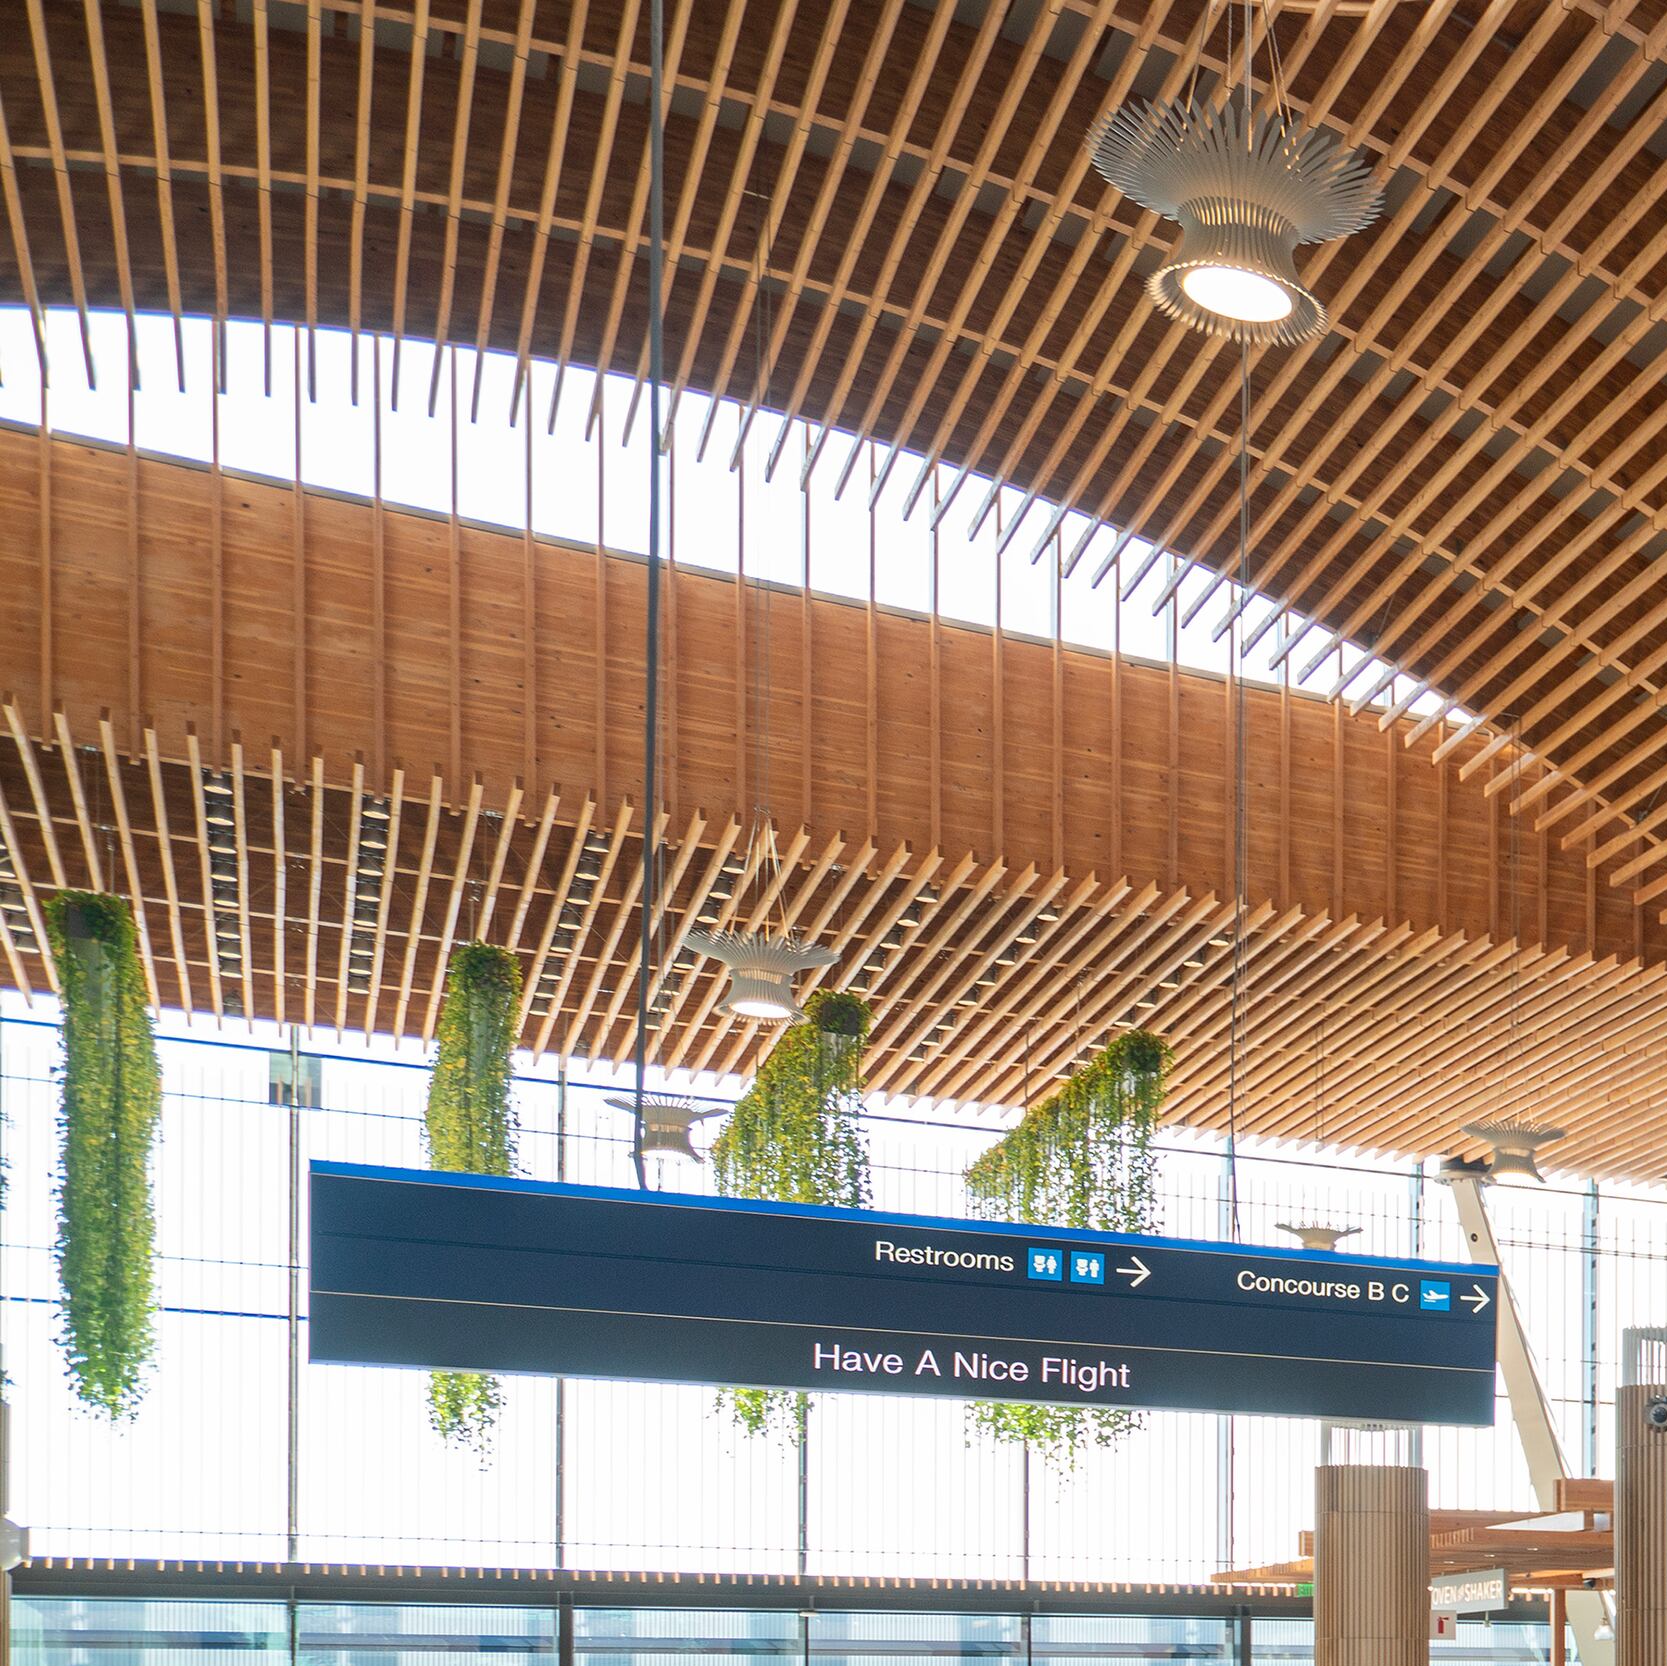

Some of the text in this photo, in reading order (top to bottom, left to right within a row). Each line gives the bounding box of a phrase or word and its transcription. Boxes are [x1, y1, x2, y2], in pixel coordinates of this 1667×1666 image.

[875, 1240, 1014, 1272] Restrooms
[1237, 1270, 1410, 1303] Concourse B C
[814, 1342, 1130, 1392] Have A Nice Flight
[1431, 1580, 1502, 1606] OVEN SHAKER
